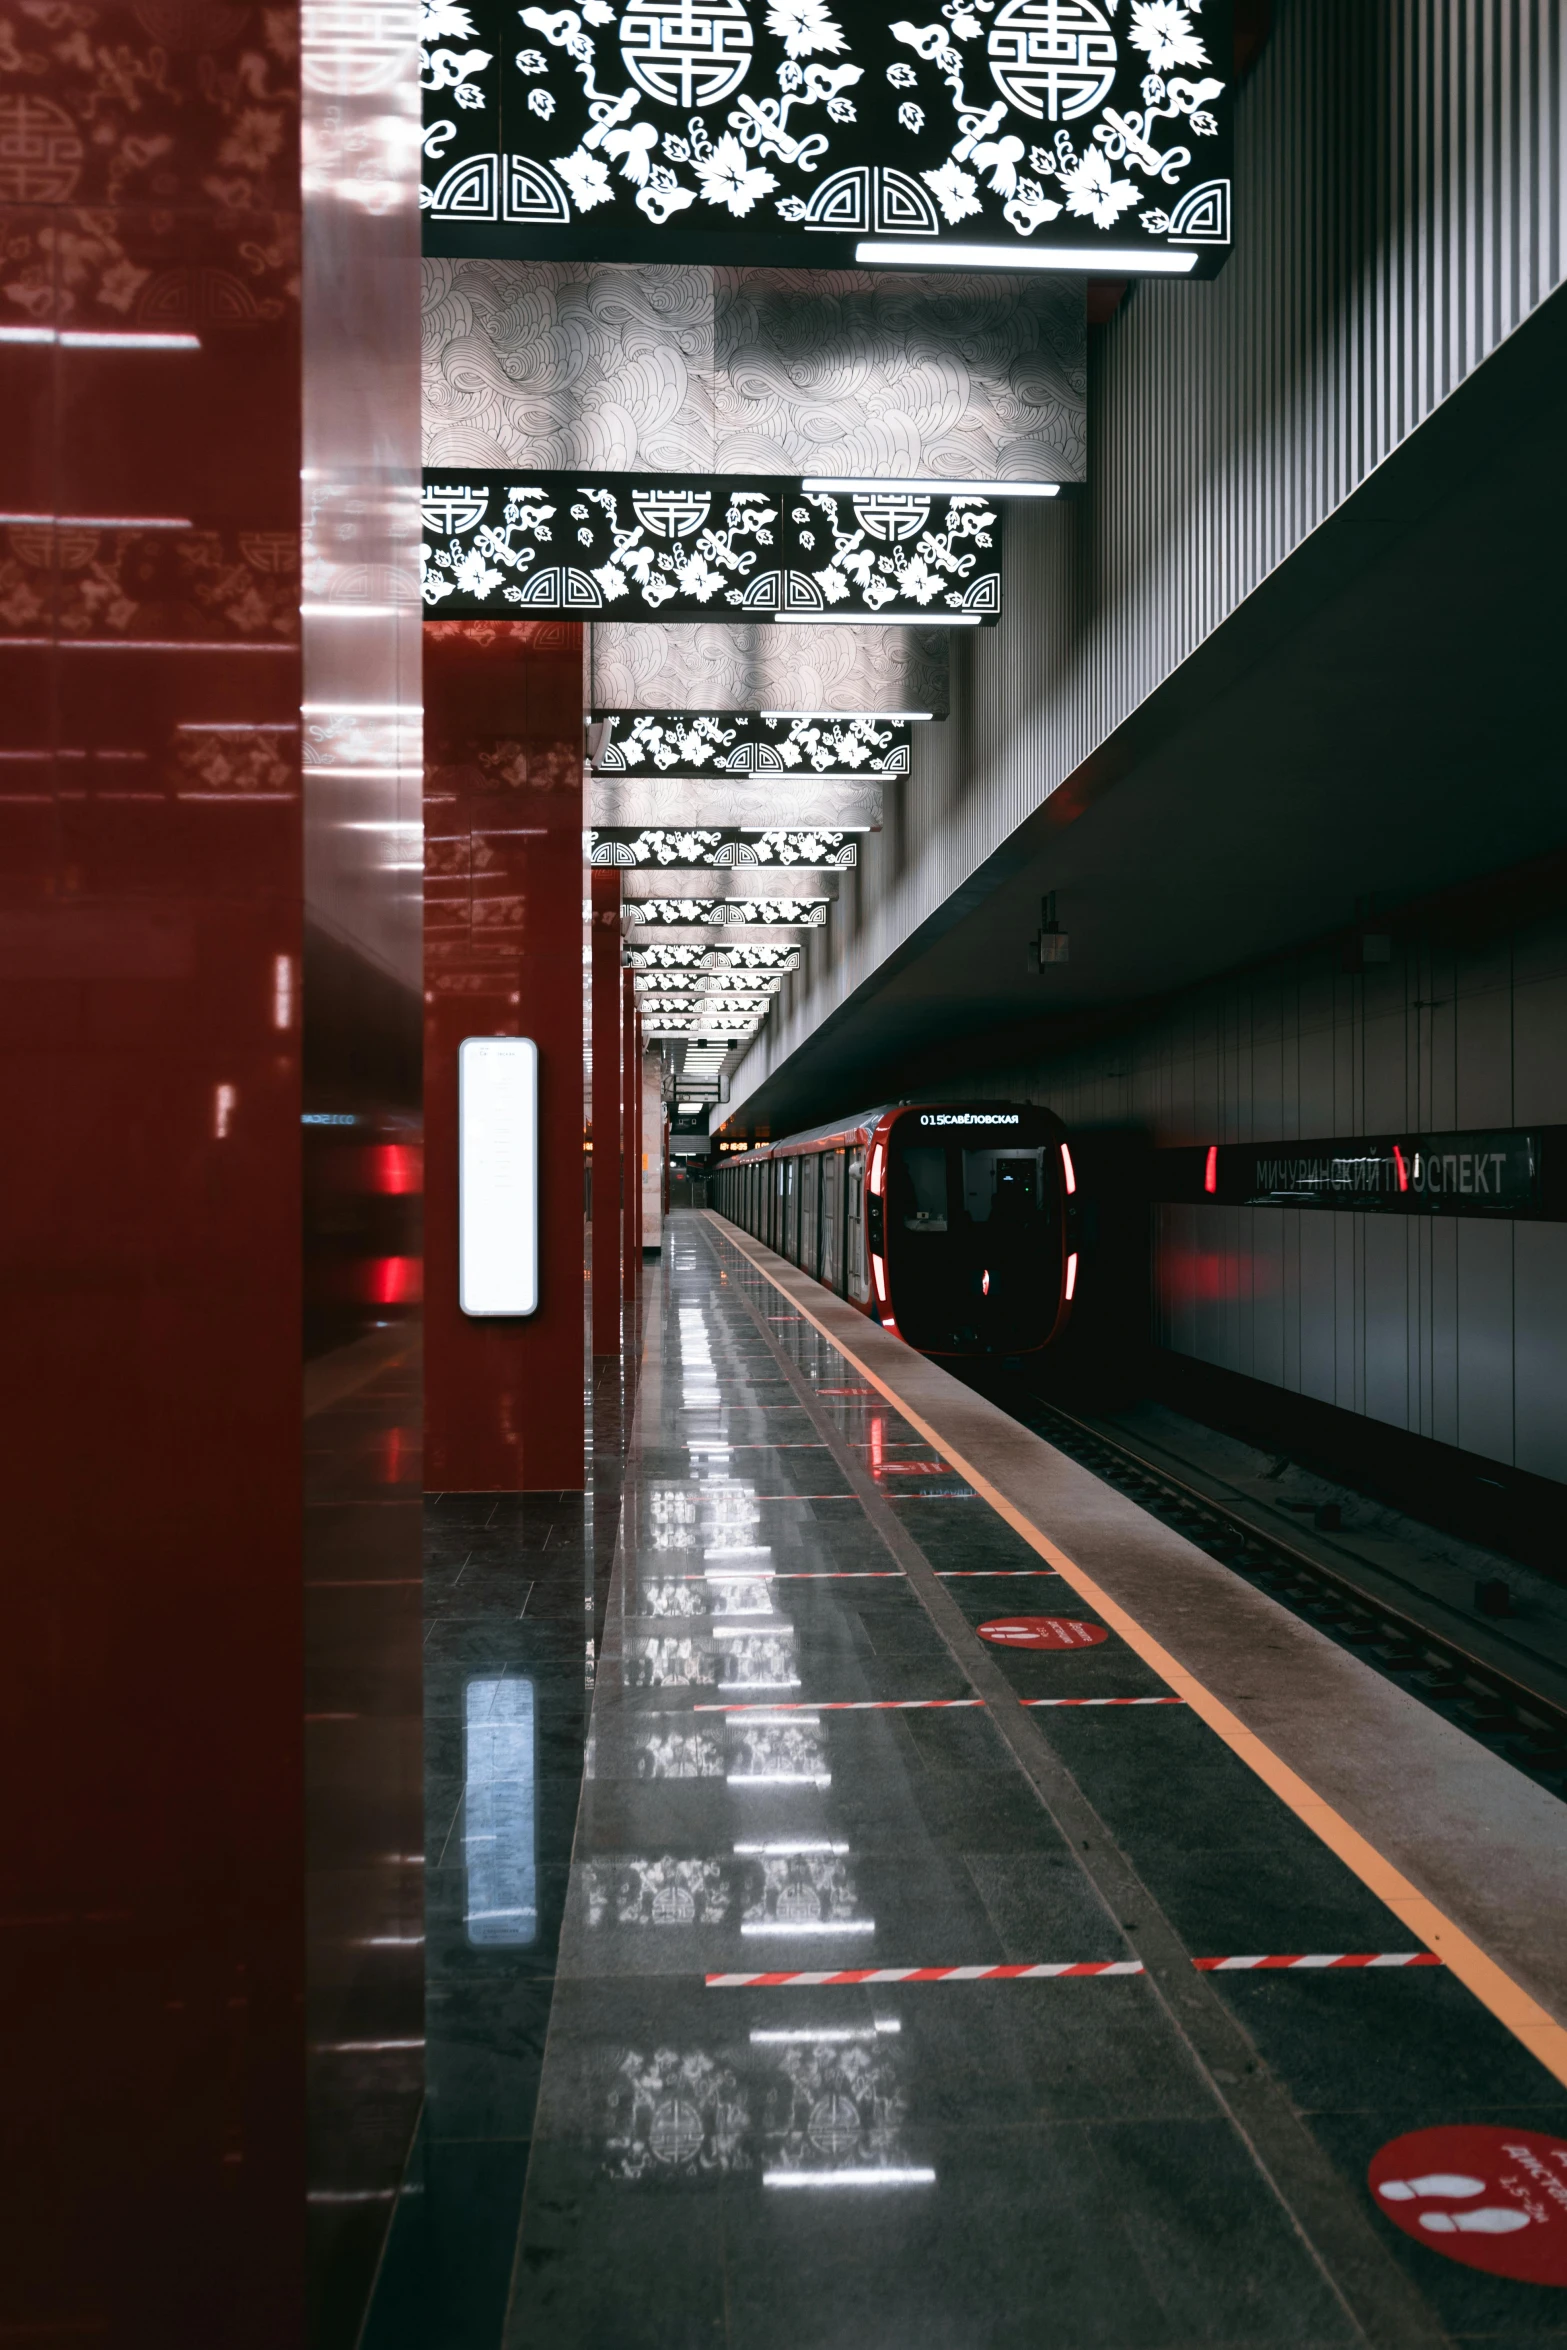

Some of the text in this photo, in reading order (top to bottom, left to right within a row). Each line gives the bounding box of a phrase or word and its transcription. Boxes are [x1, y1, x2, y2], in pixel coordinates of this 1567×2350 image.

[920, 1113, 1019, 1126] 015 САВЁЛОВСКАЯ
[1256, 1147, 1380, 1192] МИЧУРИНСКИЙ
